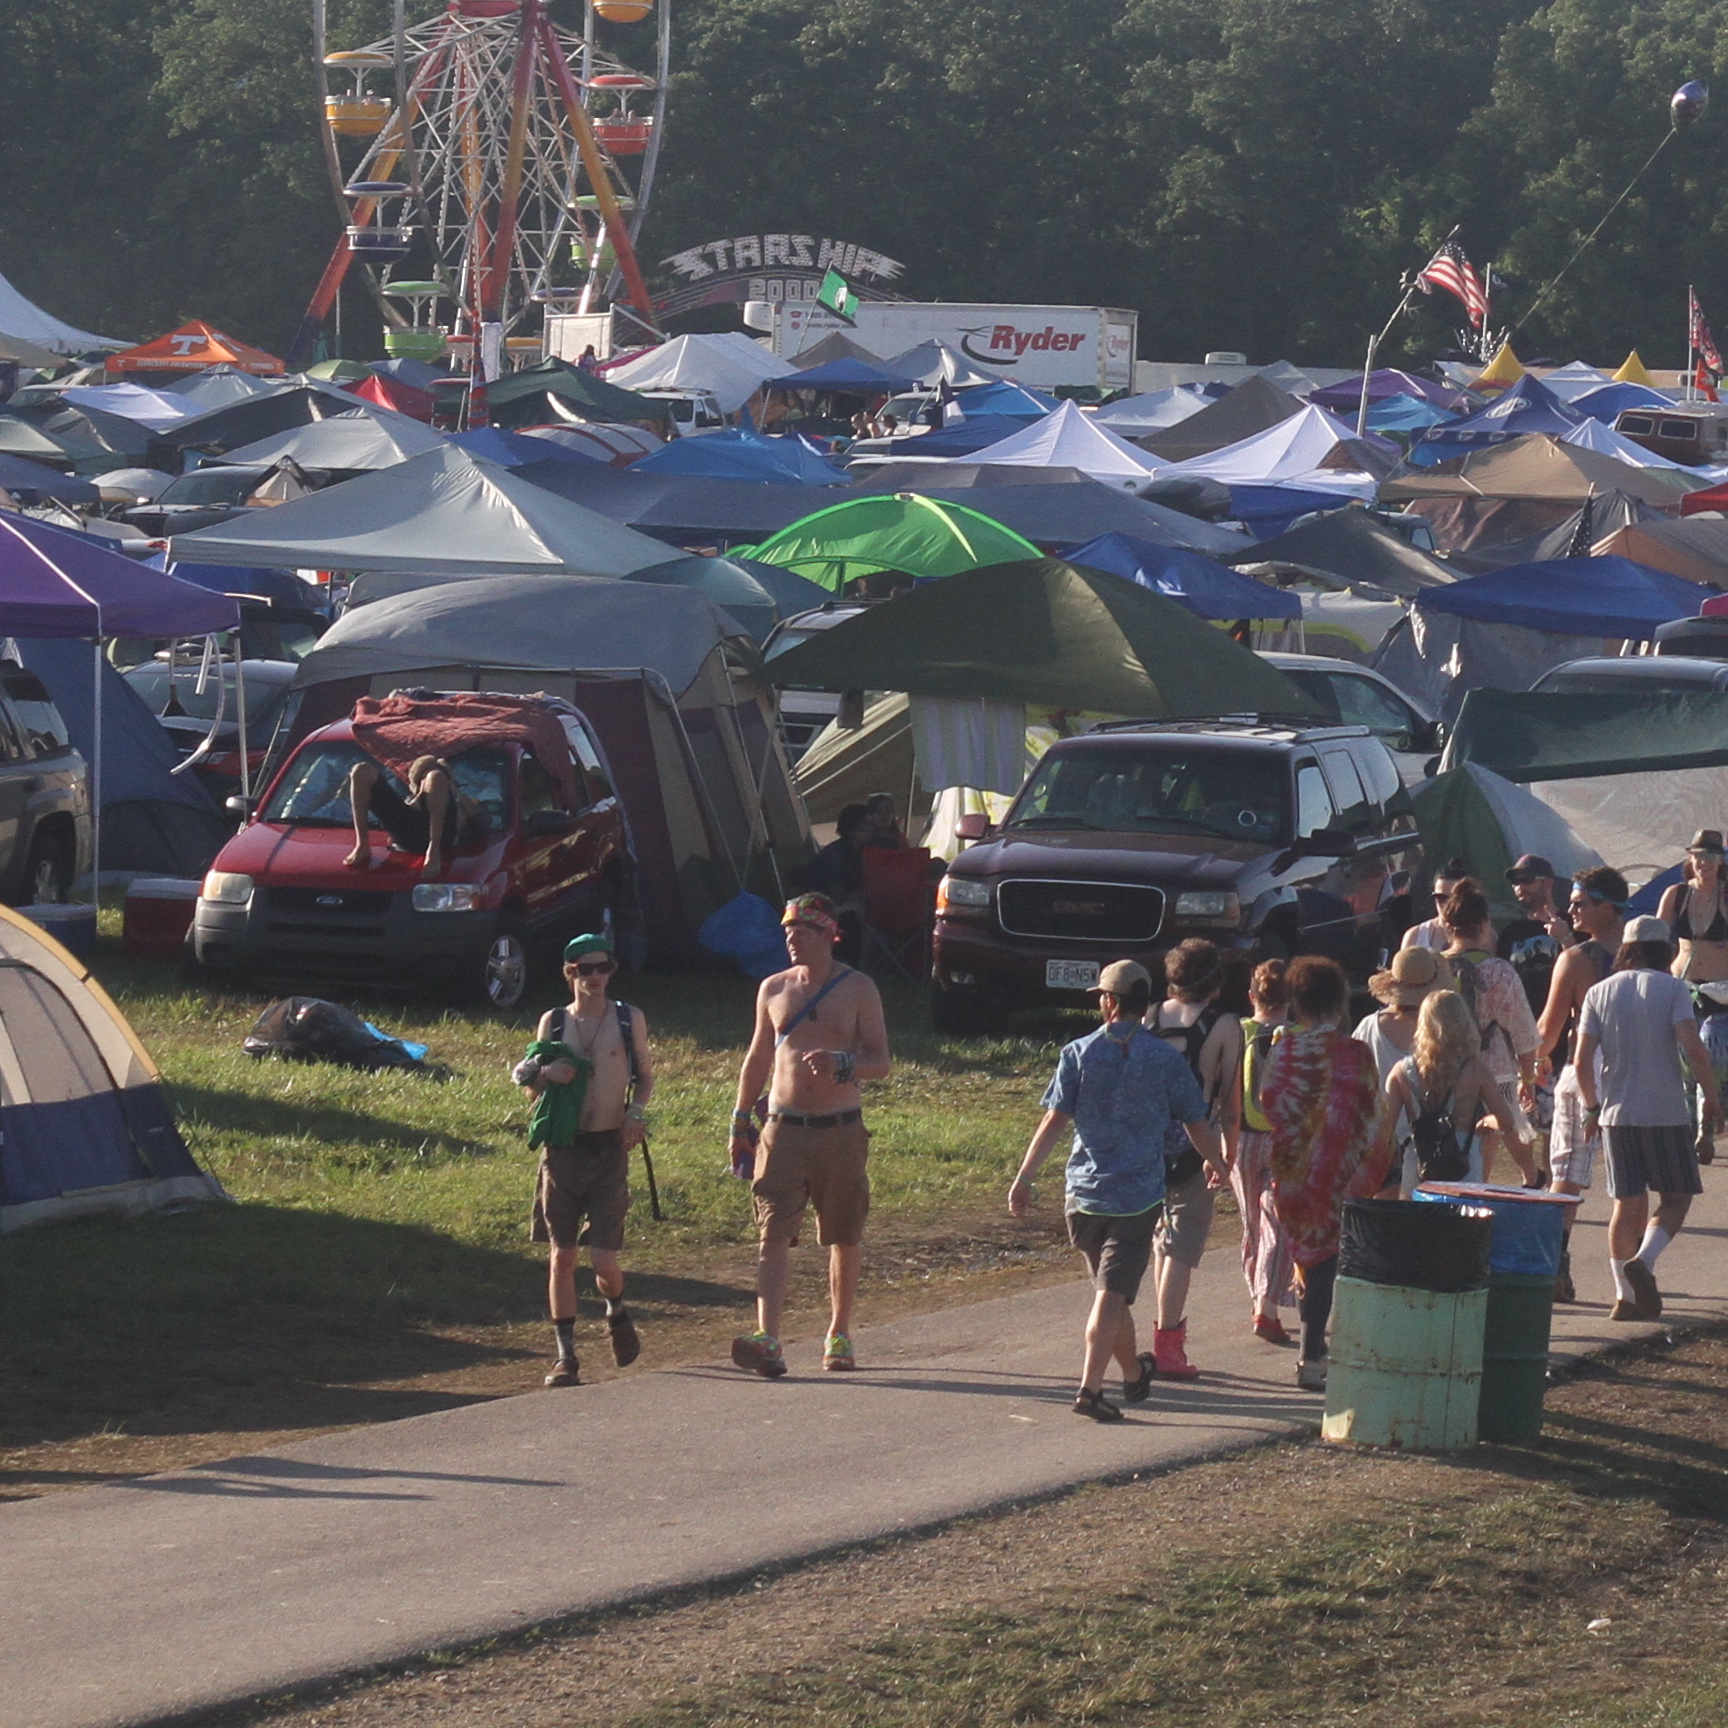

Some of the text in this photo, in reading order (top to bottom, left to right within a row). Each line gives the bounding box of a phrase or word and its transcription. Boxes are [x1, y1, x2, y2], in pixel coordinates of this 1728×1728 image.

[658, 234, 907, 281] STARSHIP
[750, 279, 820, 301] 2000
[989, 325, 1086, 356] Ryder
